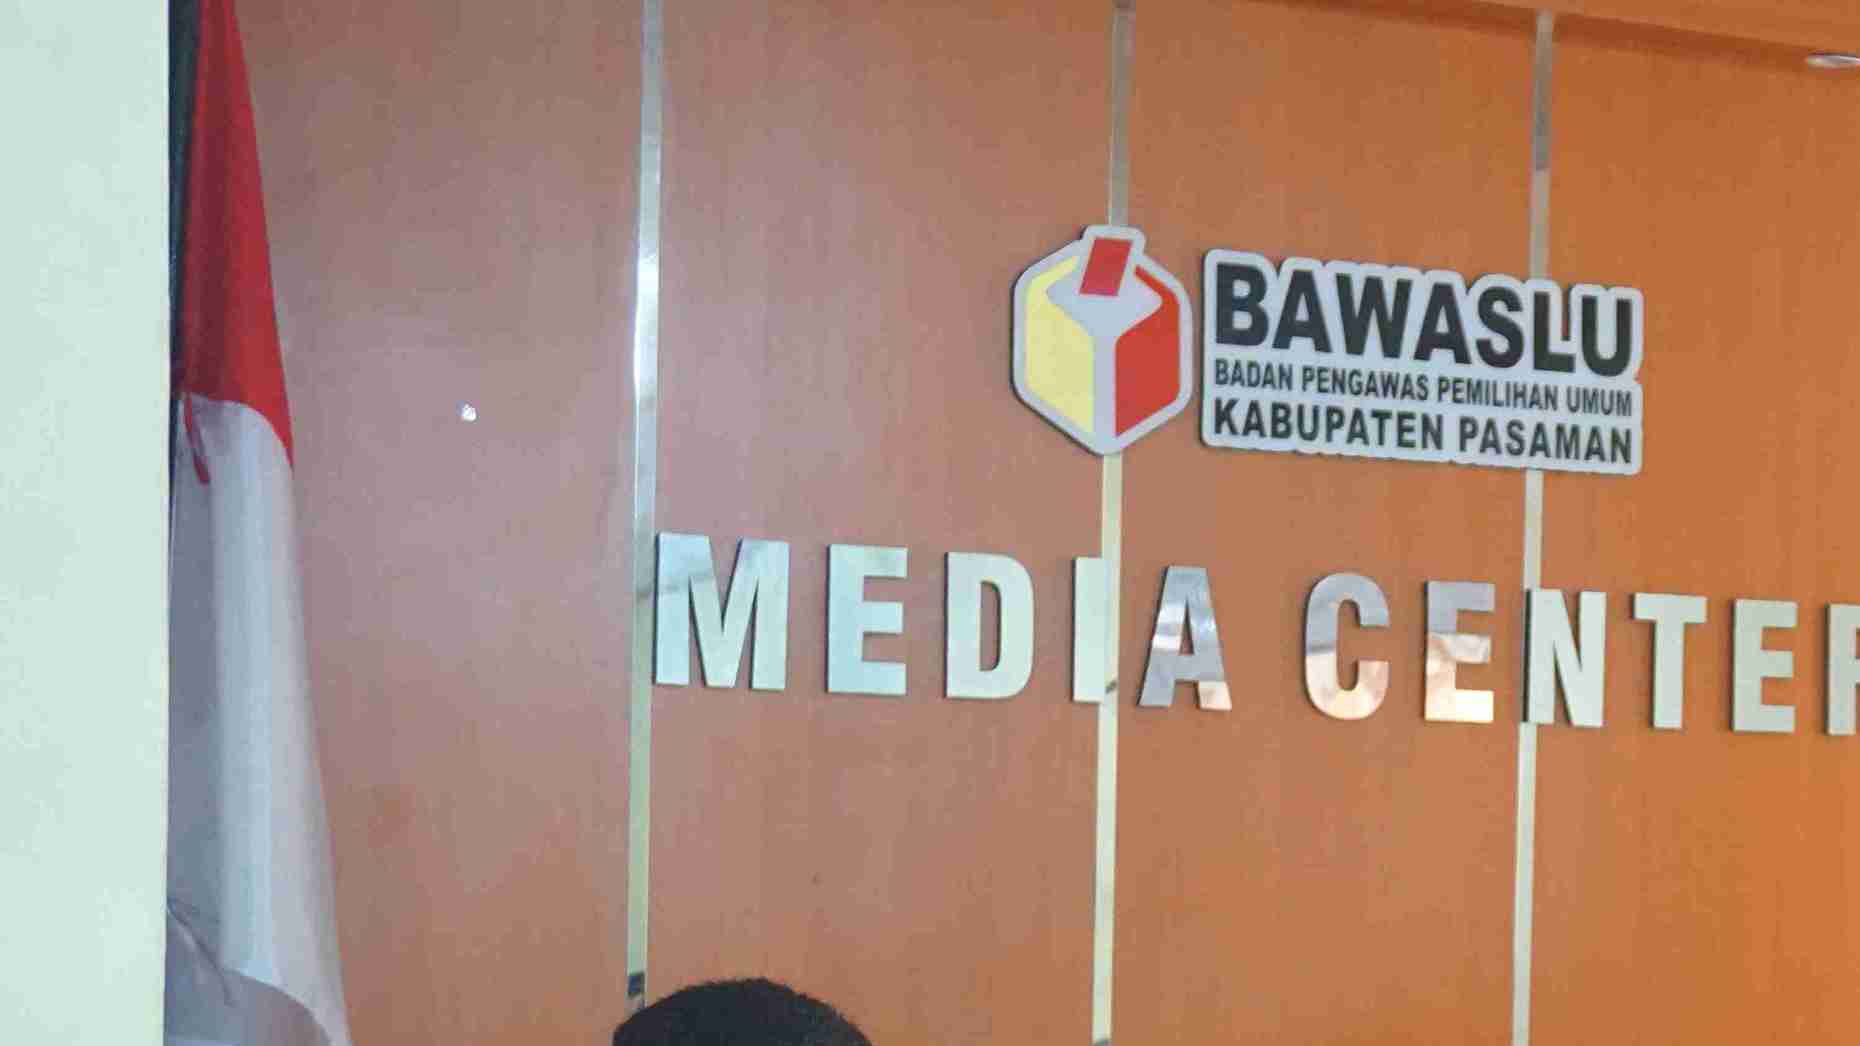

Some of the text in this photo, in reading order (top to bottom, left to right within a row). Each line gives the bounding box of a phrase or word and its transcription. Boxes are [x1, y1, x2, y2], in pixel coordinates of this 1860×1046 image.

[1215, 262, 1634, 378] BAWASLU
[1213, 397, 1633, 464] KABUPATEN PASAMAN
[1214, 358, 1633, 418] BADAN PENGAWAS PEMILIHAN UMUM
[654, 531, 1233, 711] MEDIA
